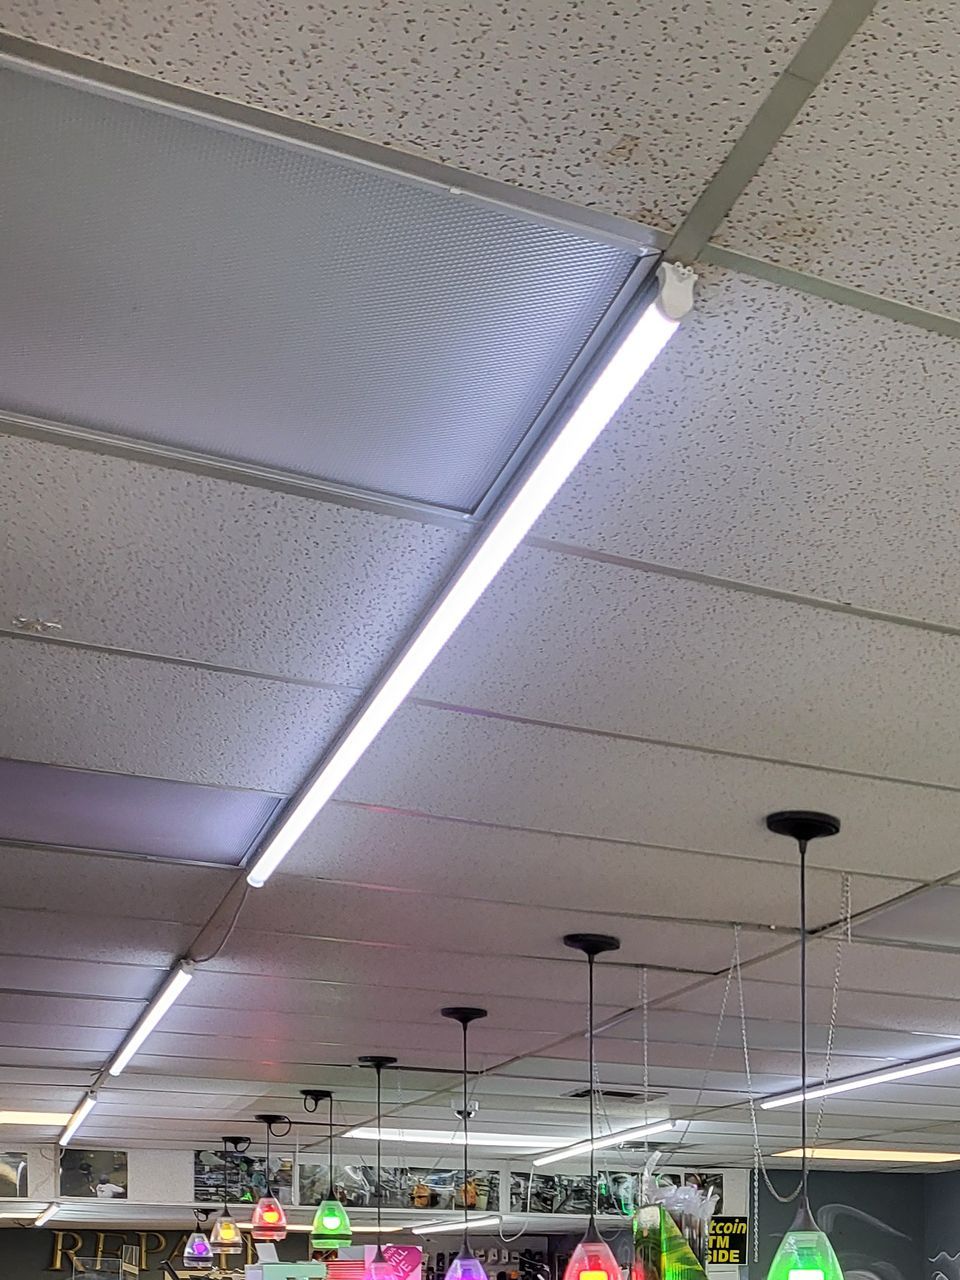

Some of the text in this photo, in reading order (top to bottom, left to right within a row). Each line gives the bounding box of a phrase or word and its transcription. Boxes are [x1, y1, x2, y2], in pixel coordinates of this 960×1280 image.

[709, 1219, 747, 1235] tcoin
[708, 1236, 730, 1248] TM
[707, 1250, 740, 1263] SIDE
